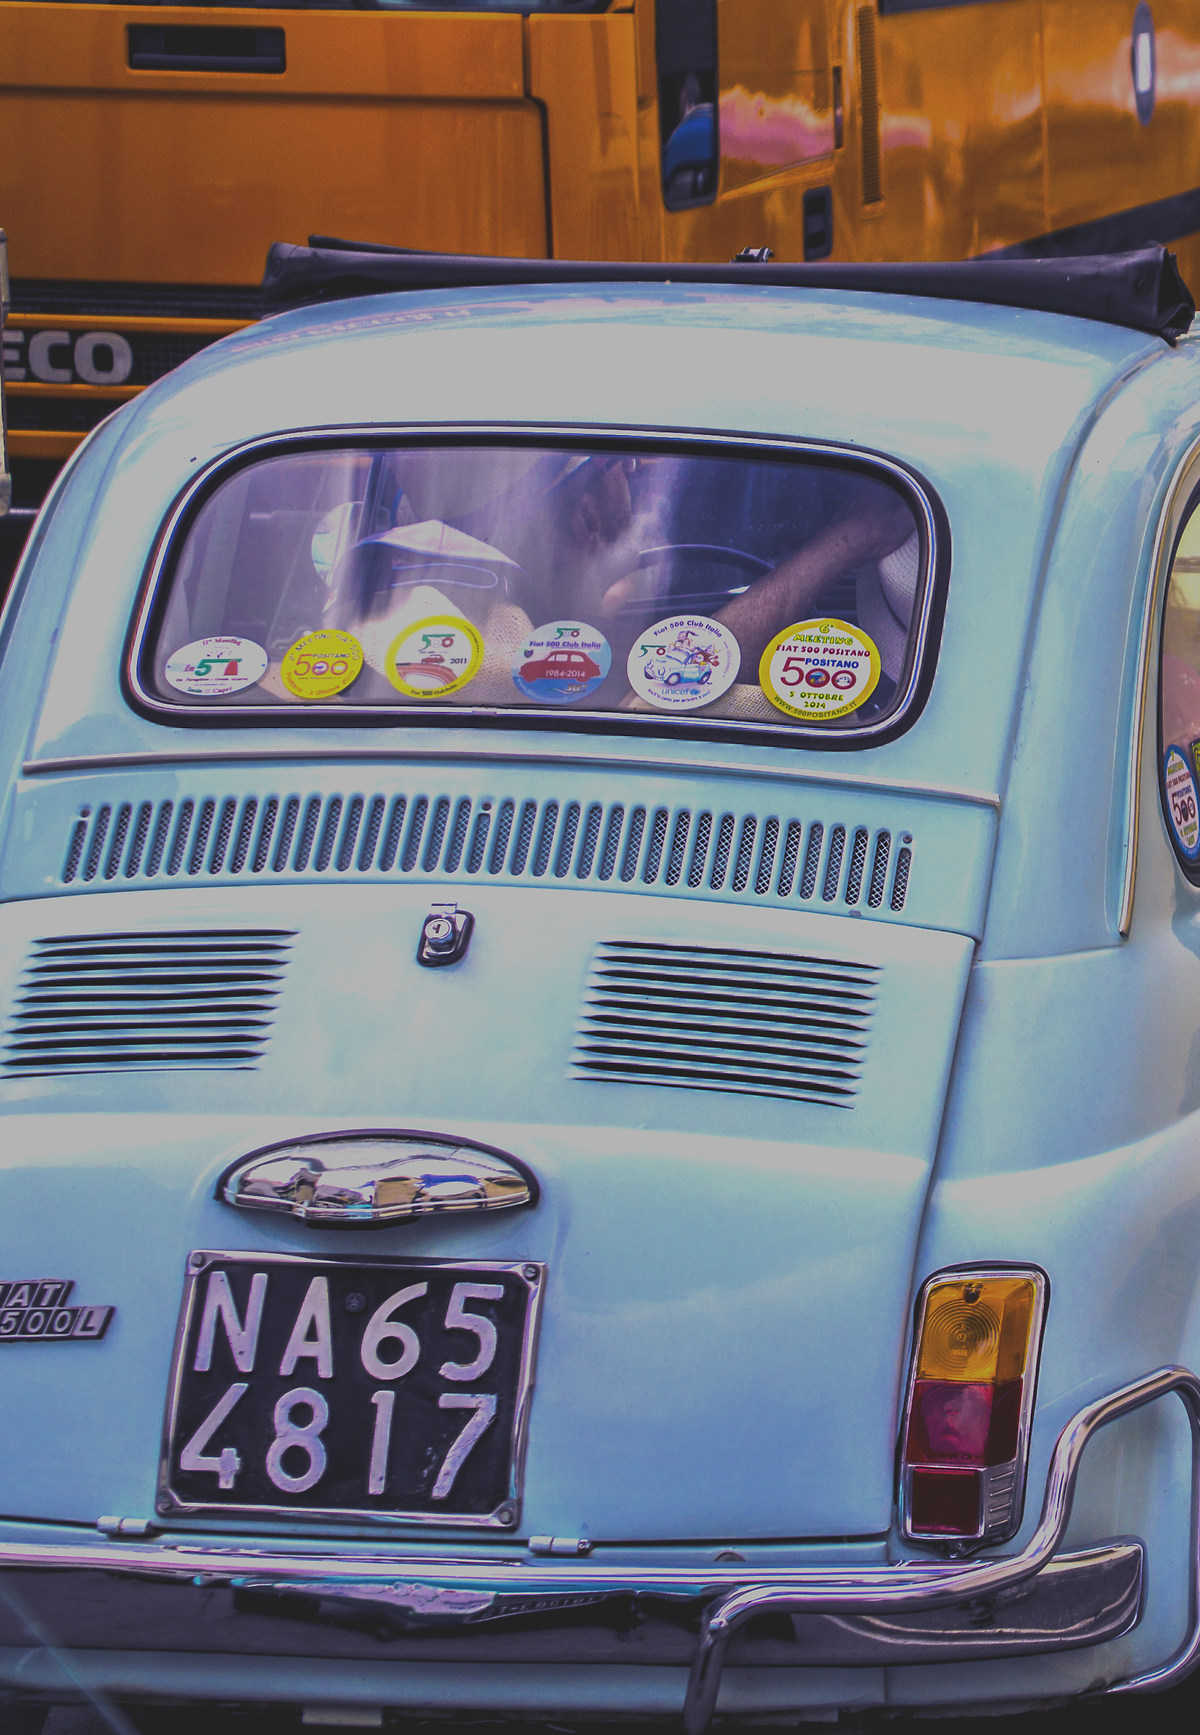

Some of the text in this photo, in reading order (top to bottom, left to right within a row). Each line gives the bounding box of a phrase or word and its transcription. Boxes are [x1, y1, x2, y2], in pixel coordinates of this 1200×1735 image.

[653, 620, 722, 638] Fiat 500 Club Italia
[793, 634, 853, 645] MEETING
[776, 644, 870, 657] FIAT 500 POSITANO
[294, 654, 348, 676] 500
[804, 658, 859, 669] POSITANO
[780, 656, 857, 690] 500
[800, 691, 844, 701] OTTOBRE
[804, 701, 826, 709] 2014
[0, 1310, 96, 1334] 500L
[180, 1382, 498, 1500] 4817
